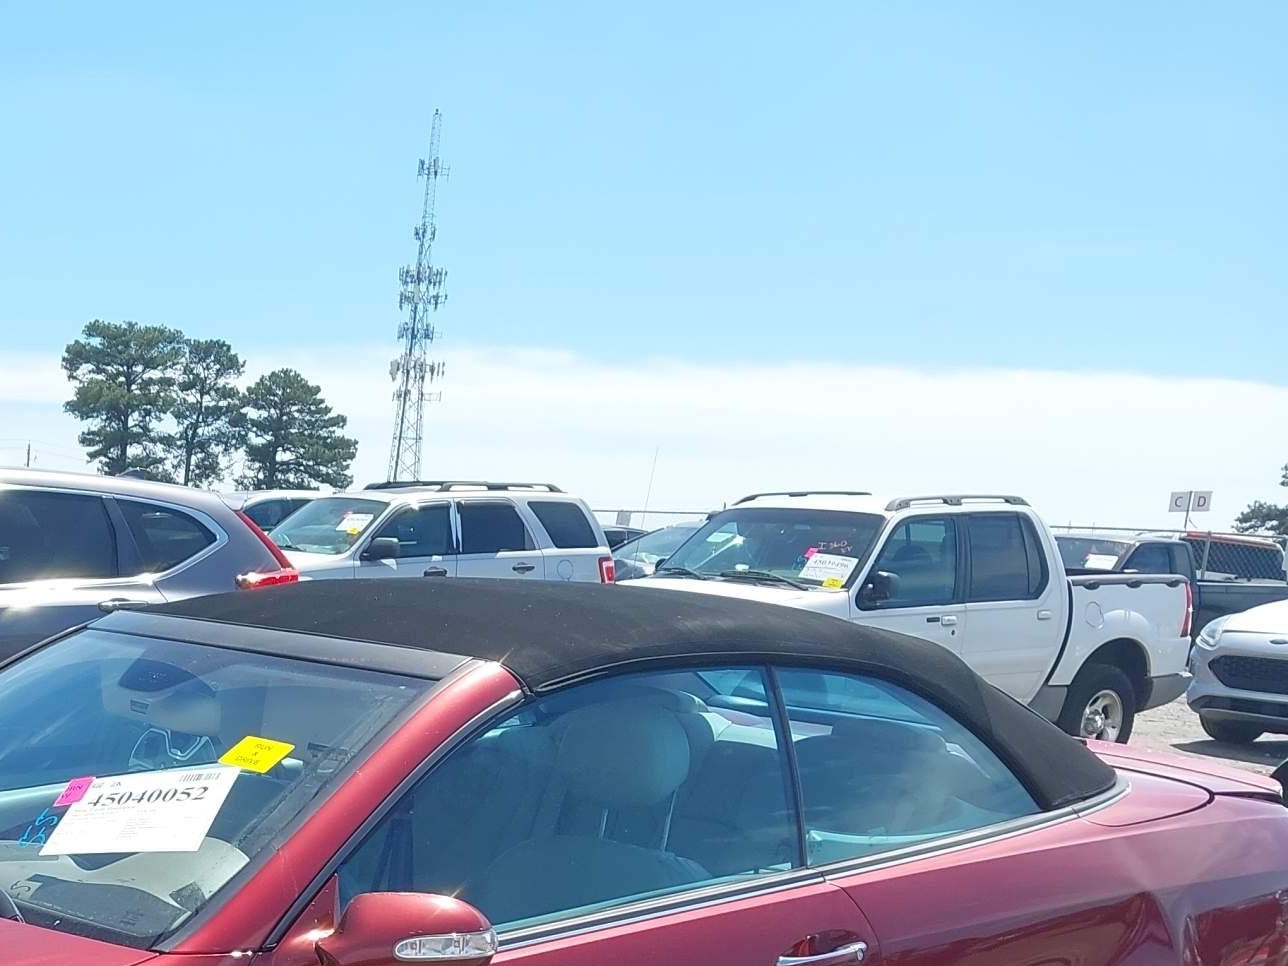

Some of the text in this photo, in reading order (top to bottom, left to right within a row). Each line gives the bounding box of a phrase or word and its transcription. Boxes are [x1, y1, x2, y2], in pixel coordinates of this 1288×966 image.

[1174, 496, 1184, 508] C
[1196, 496, 1207, 508] D
[87, 786, 209, 807] 45040052
